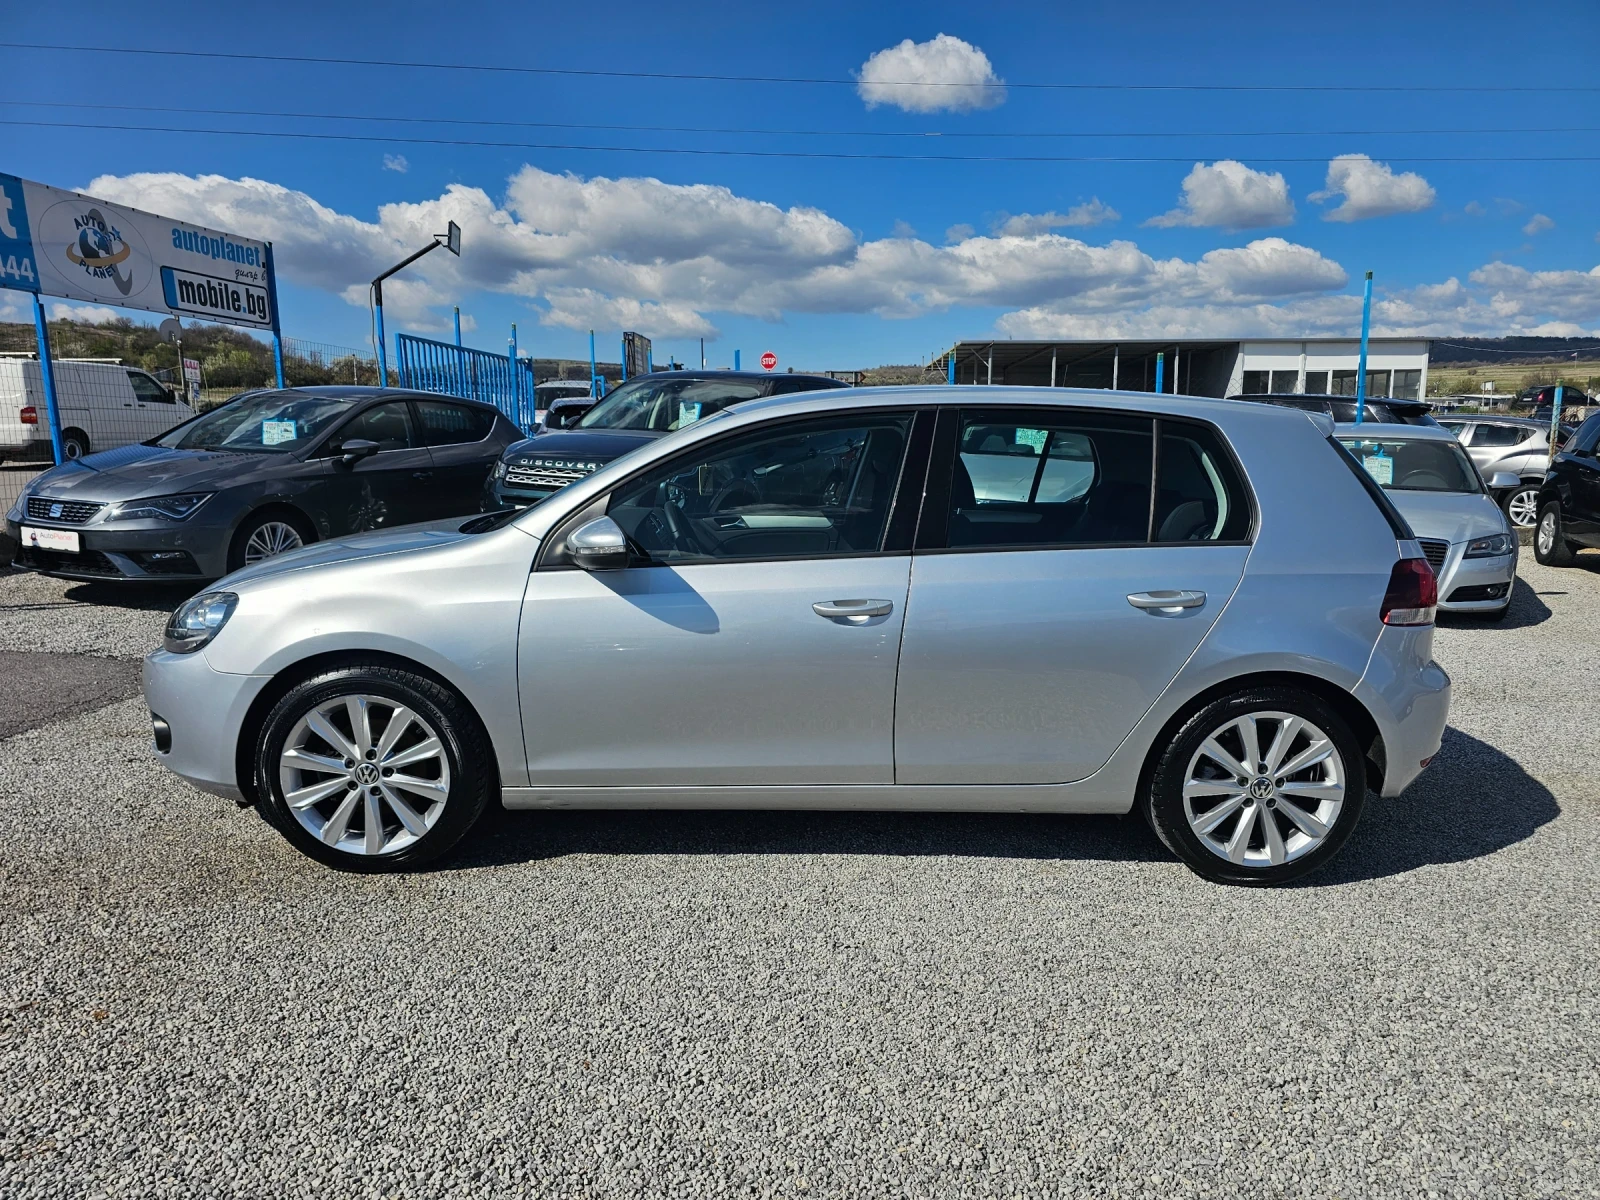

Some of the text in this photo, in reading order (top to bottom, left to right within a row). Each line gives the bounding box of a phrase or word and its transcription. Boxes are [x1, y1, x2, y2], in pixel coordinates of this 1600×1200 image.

[74, 214, 106, 232] AUTO
[79, 259, 116, 280] PLANET
[177, 278, 267, 320] mobile.bg
[762, 357, 776, 365] STOP
[520, 458, 604, 470] DISCOVER
[39, 532, 73, 541] AutoPlanet
